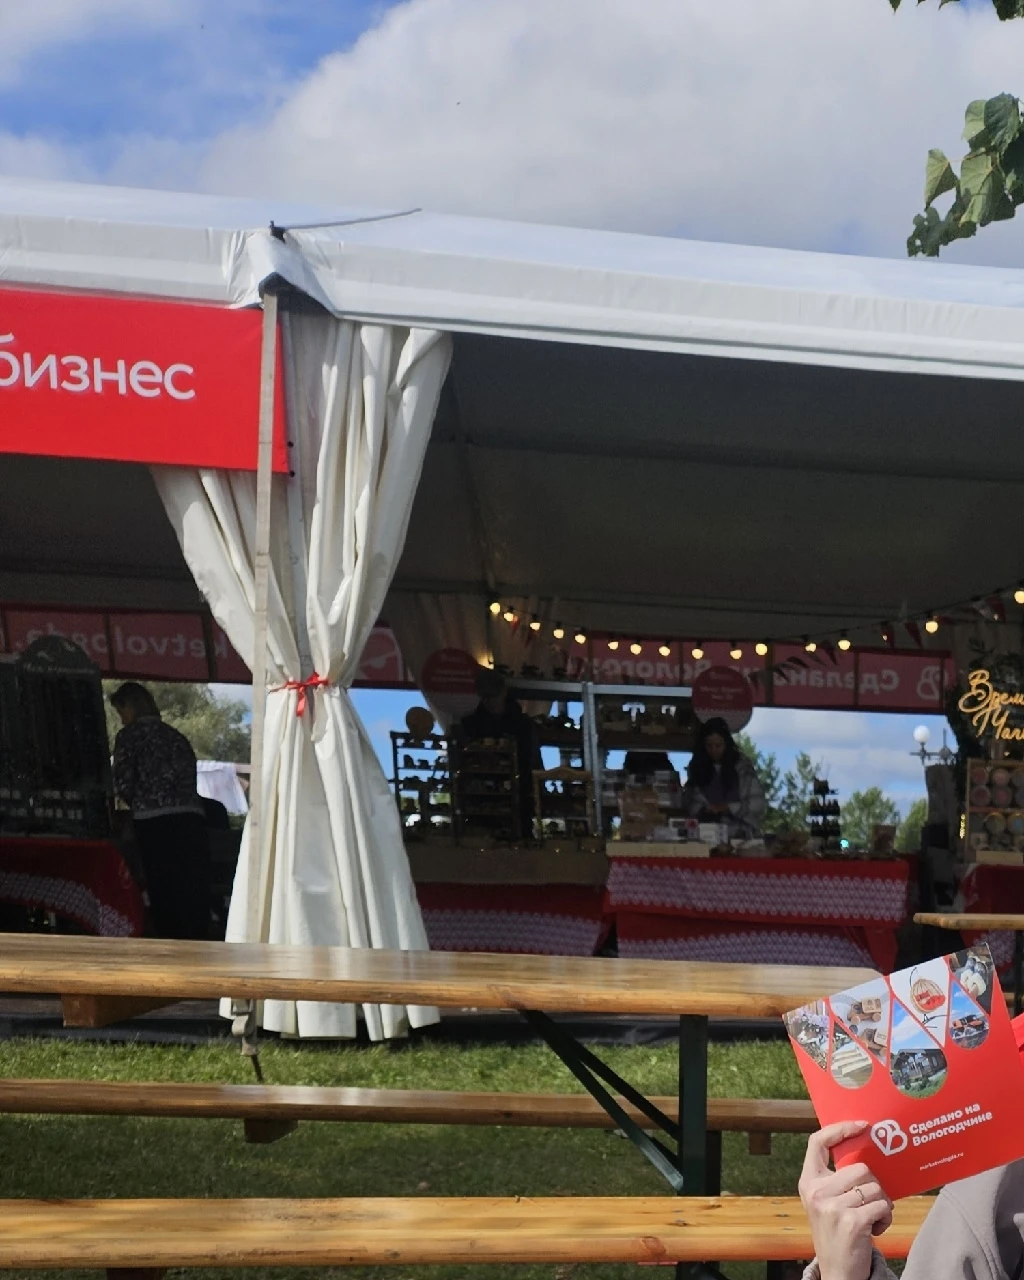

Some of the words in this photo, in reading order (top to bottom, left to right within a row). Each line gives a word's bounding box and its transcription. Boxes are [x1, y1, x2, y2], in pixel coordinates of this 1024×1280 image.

[0, 331, 196, 400] бизнес
[909, 1110, 963, 1134] Сделано
[965, 1103, 980, 1115] на
[912, 1111, 993, 1147] Вологодчине
